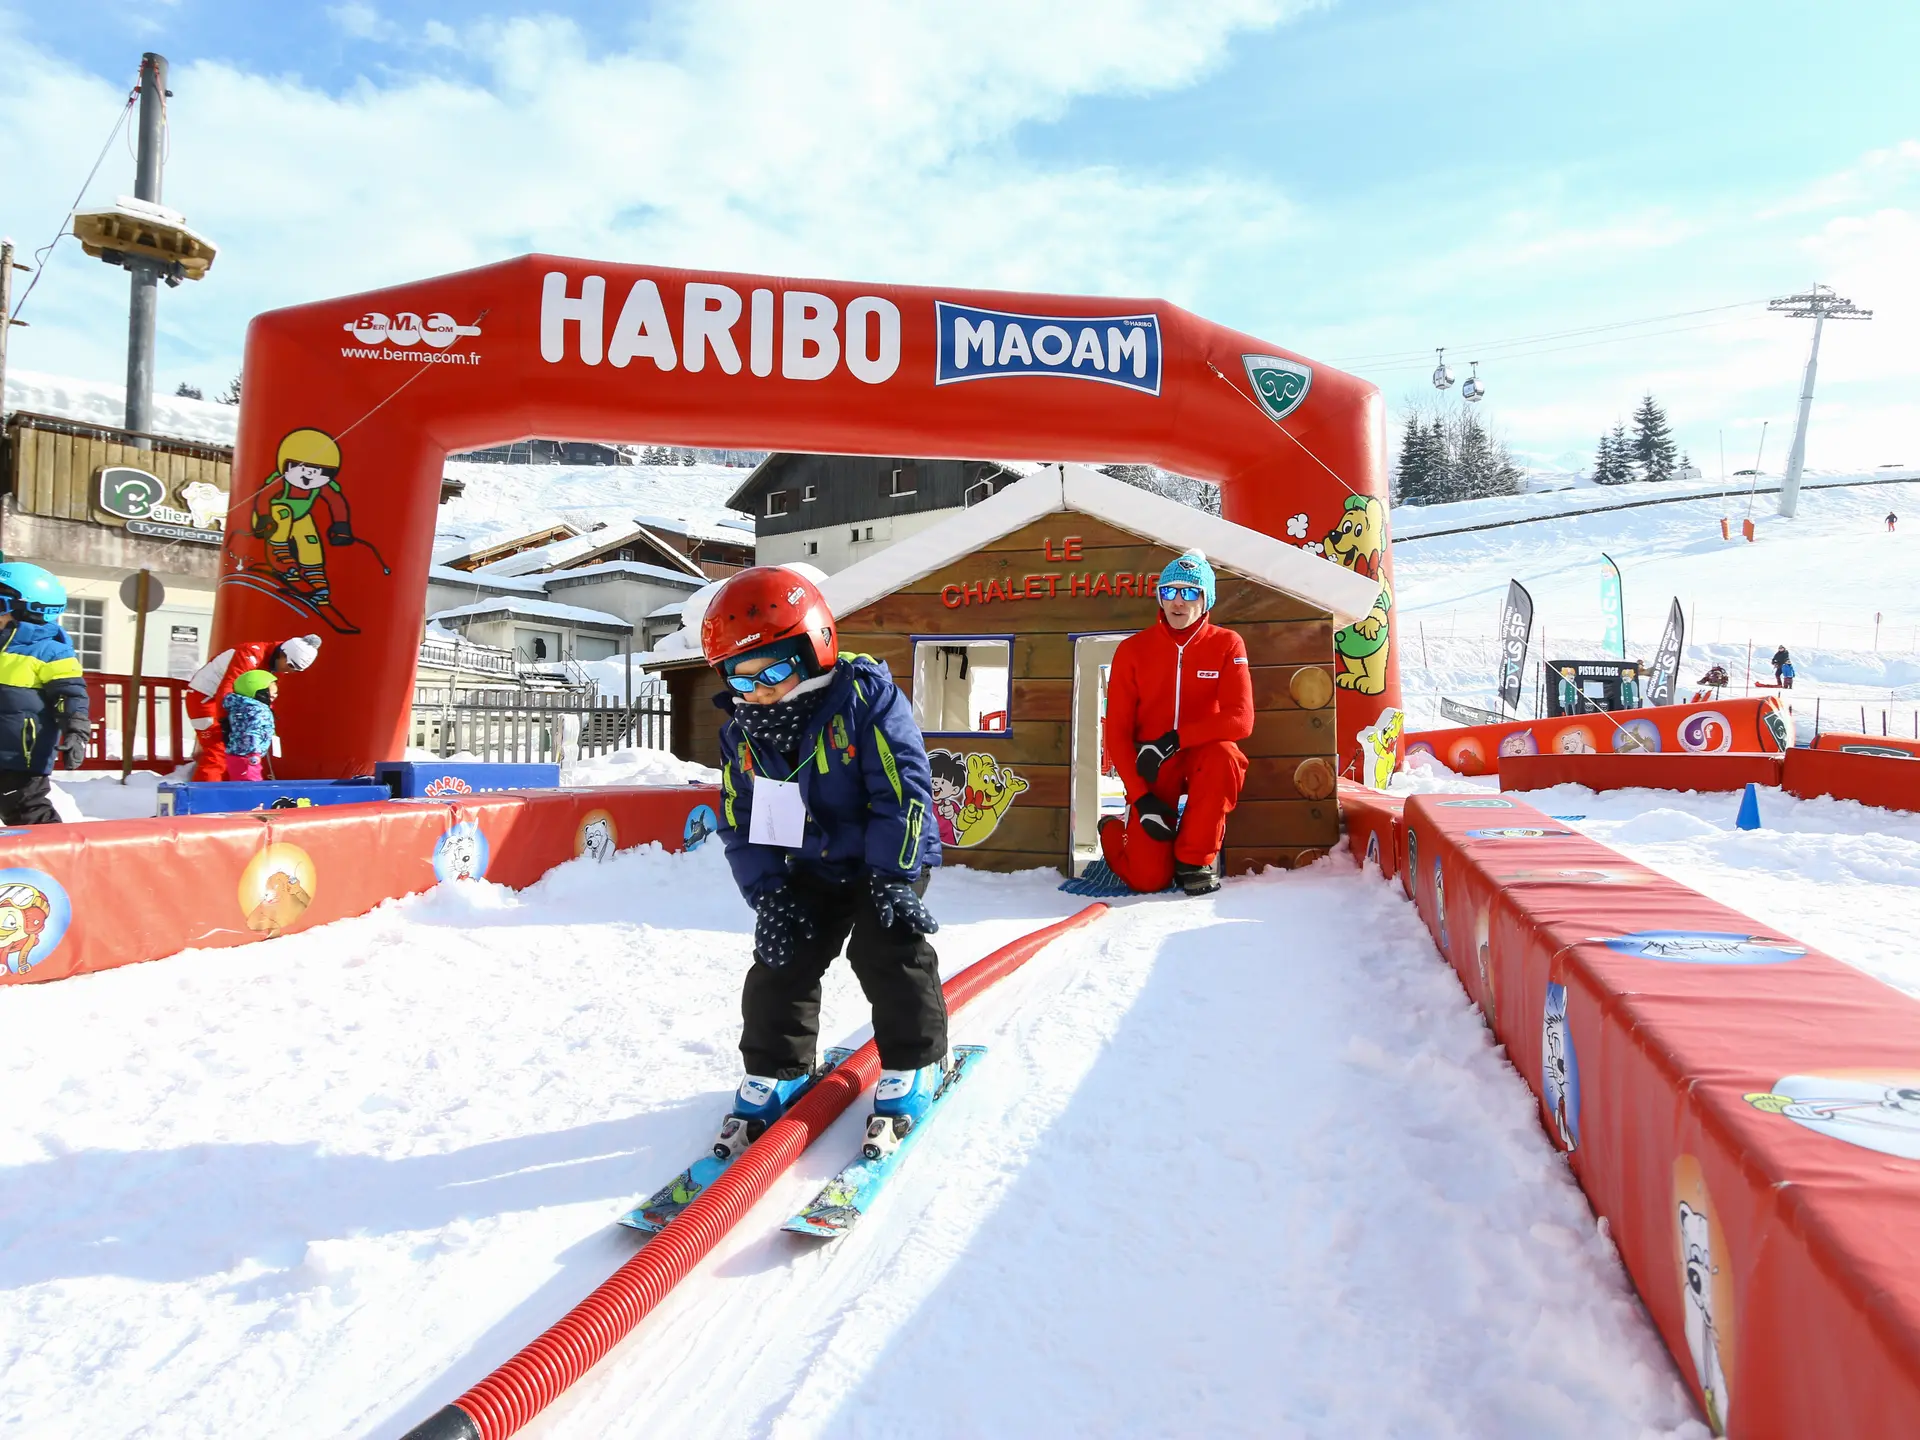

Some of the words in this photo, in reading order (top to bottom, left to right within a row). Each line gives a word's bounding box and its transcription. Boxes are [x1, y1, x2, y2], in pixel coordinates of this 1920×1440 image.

[540, 271, 901, 385] HARIBO
[341, 347, 482, 365] www.bermacom.fr
[953, 315, 1147, 379] MAOAM
[1044, 537, 1083, 562] LE
[941, 575, 1057, 609] CHALET
[1578, 665, 1594, 676] PISTE
[1595, 666, 1603, 676] DE
[1603, 666, 1619, 677] LUGE
[425, 776, 473, 797] HARIBO
